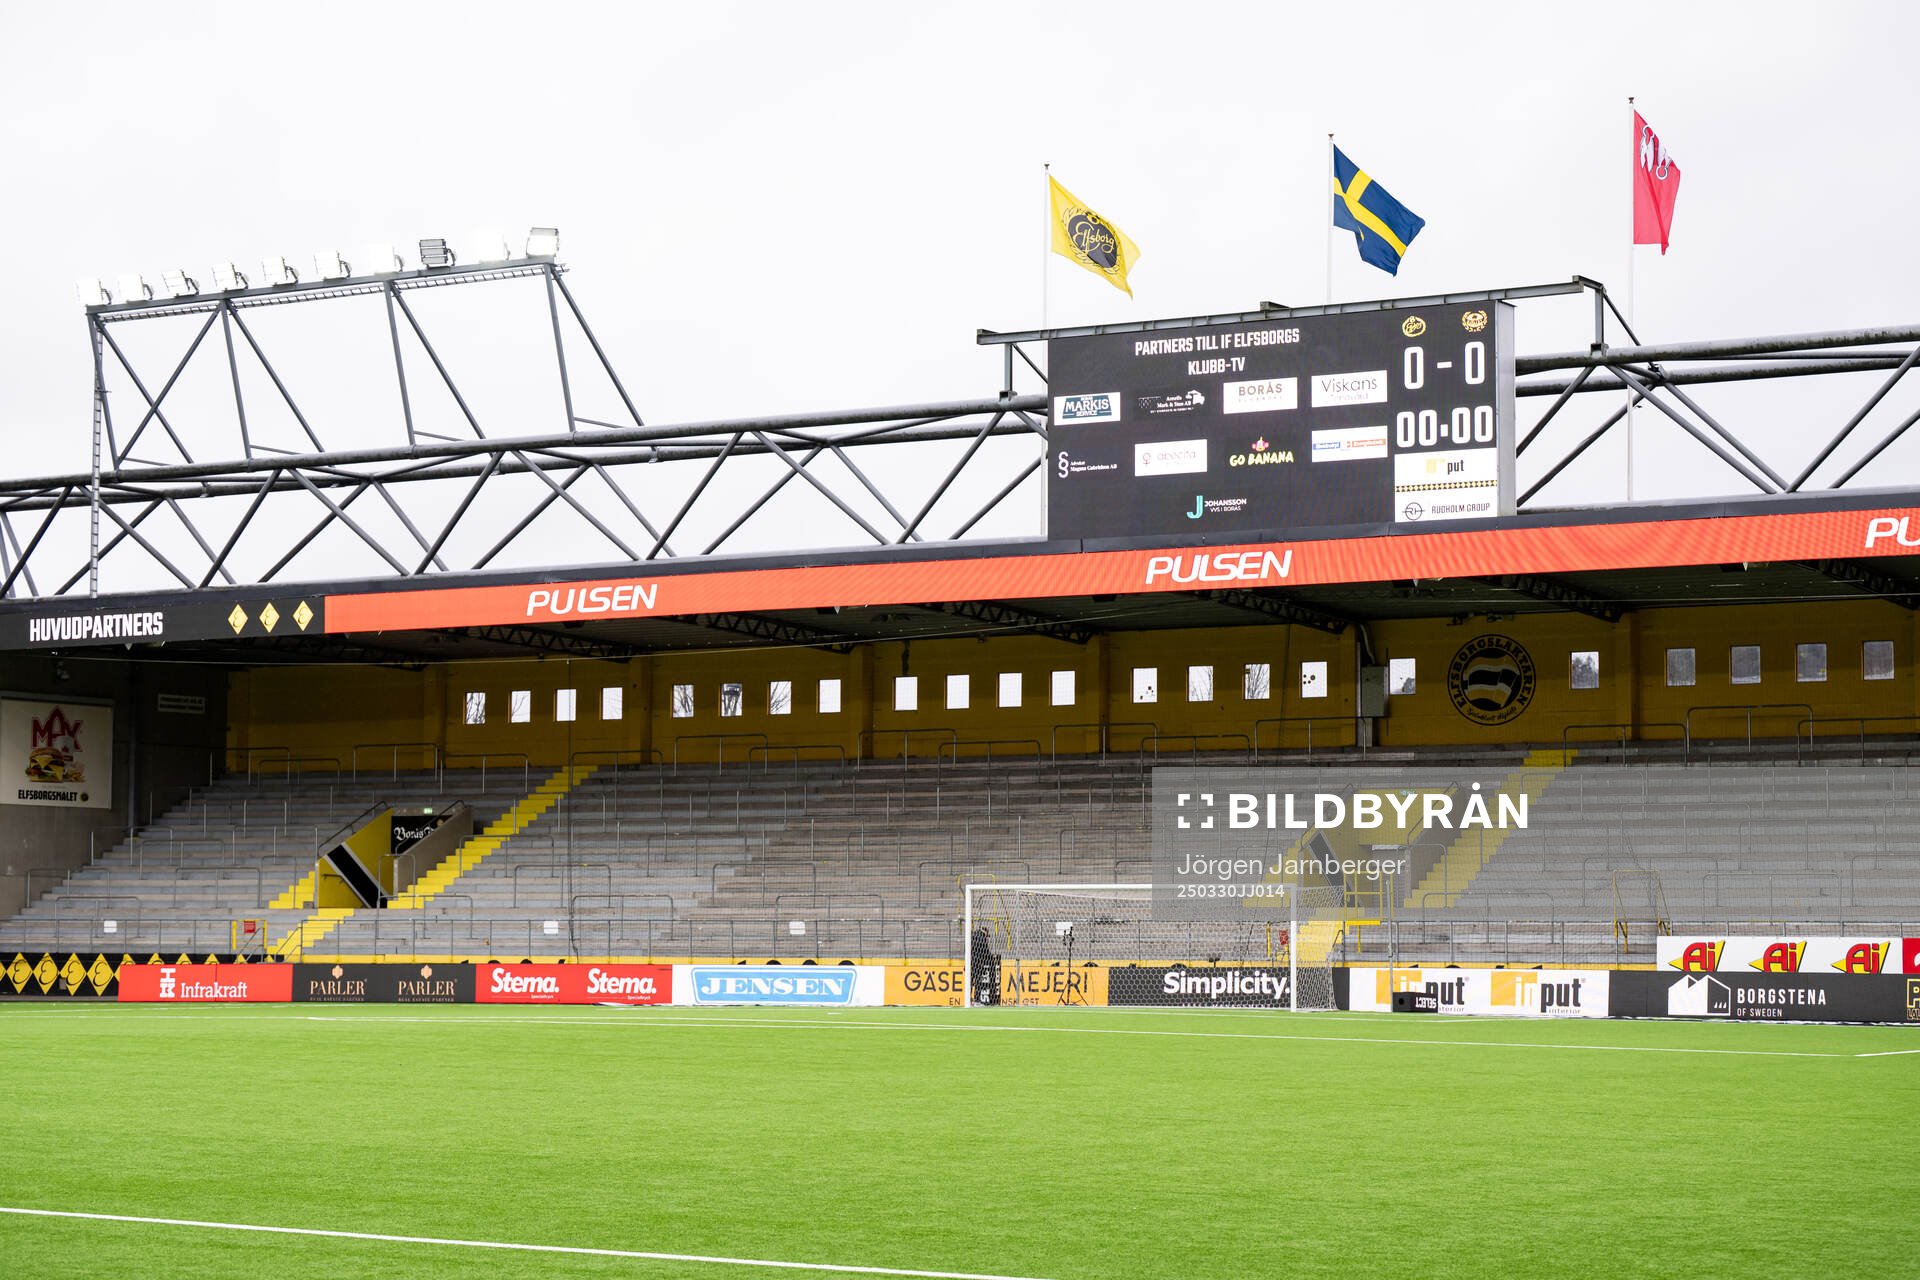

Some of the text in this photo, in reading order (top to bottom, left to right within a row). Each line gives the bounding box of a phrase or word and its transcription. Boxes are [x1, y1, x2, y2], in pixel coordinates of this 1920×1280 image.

[1135, 328, 1300, 356] PARTNERS TILL IF ELFSBORGS
[1188, 356, 1246, 376] KLUBB-TV
[1404, 346, 1424, 389] 0
[1465, 341, 1485, 385] 0
[1238, 383, 1283, 396] BORÅS
[1321, 378, 1378, 393] Viskans
[1065, 399, 1110, 412] MARKIS
[1229, 451, 1294, 467] GO BANANA
[1204, 499, 1247, 507] JOHANSSON
[1431, 503, 1491, 514] RUDHOLM GROUP
[1145, 549, 1293, 585] PULSEN
[526, 583, 658, 617] PULSEN
[29, 611, 164, 642] HUVUDPARTNERS
[310, 980, 366, 995] PARLER
[398, 980, 455, 995] PARLER
[491, 967, 560, 993] Stema.
[586, 968, 657, 994] Stema.
[701, 977, 846, 996] JENSEN
[1006, 971, 1088, 993] MEJERI
[1163, 970, 1291, 1000] Simplicity.
[180, 982, 248, 998] Infrakraft
[1737, 988, 1827, 1005] BORGSTENA
[949, 998, 961, 1006] EN
[1736, 1008, 1783, 1017] OF SWEDEN
